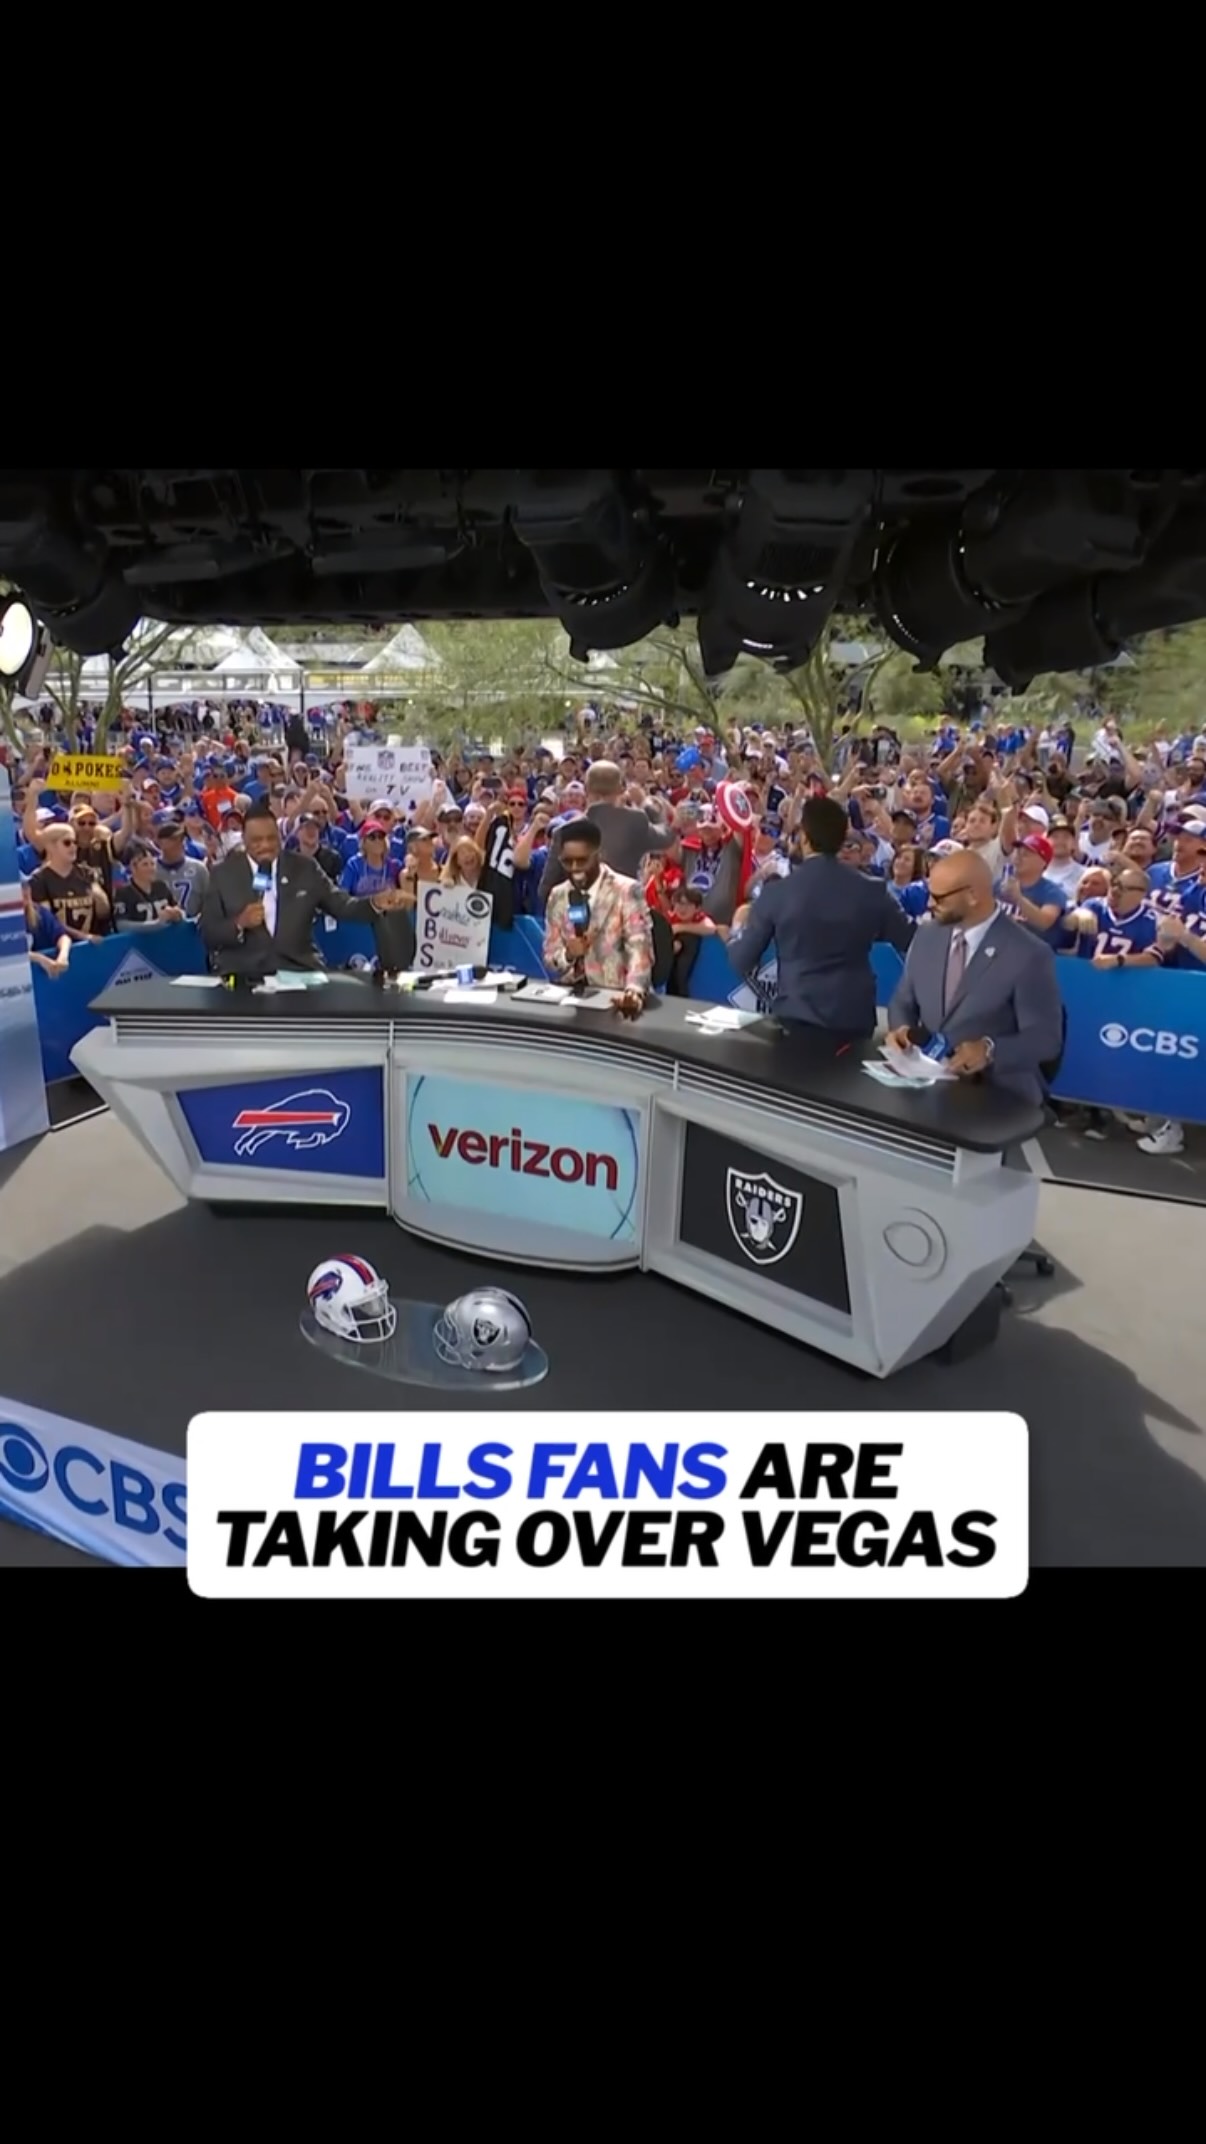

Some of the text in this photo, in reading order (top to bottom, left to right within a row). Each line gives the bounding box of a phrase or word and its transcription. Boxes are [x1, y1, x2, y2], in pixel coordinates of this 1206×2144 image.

[1130, 1027, 1199, 1059] CBS
[429, 1123, 618, 1190] verizon
[735, 1178, 791, 1208] RAIDERS
[53, 1445, 187, 1551] CBS
